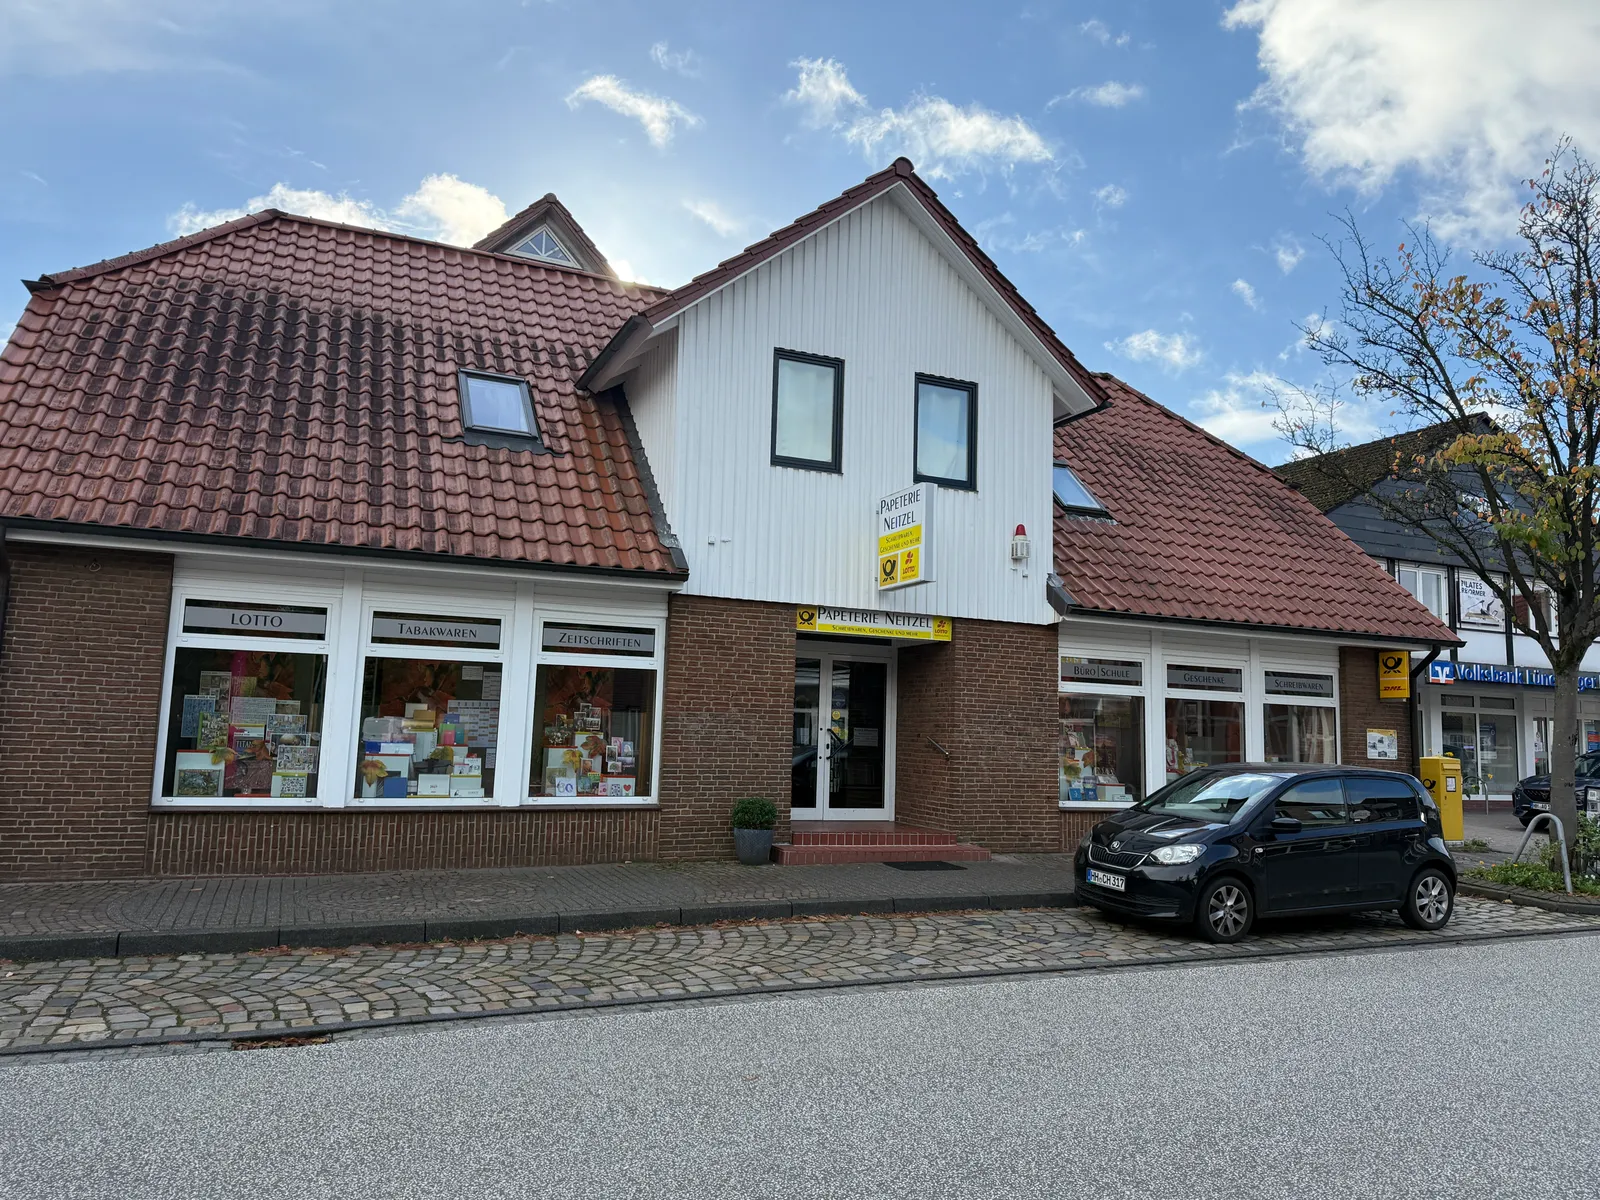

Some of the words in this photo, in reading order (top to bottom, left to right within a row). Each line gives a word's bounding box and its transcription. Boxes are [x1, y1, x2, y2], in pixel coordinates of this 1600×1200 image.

[880, 489, 921, 515] PAPETERIE
[884, 511, 916, 532] NEITZEL
[880, 542, 901, 553] GESCHENKE
[910, 536, 921, 544] MEHR
[902, 566, 916, 575] LOTTO
[1461, 580, 1483, 589] PILATES
[231, 613, 283, 627] LOTTO
[817, 606, 879, 625] PAPETERIE
[885, 612, 932, 629] NEITZEL
[397, 622, 478, 639] TABAKWAREN
[868, 627, 894, 635] GESCHENKE
[558, 632, 641, 648] ZEITSCHRIFTEN
[1073, 666, 1096, 677] BÜRO
[1100, 667, 1130, 678] SCHULE
[1183, 672, 1225, 685] GESCHENKE
[1455, 663, 1524, 684] Volksbank
[1274, 679, 1324, 691] SCHREIBWAREN
[1091, 870, 1099, 882] HH
[1102, 873, 1111, 885] CH
[1112, 876, 1125, 888] 317
